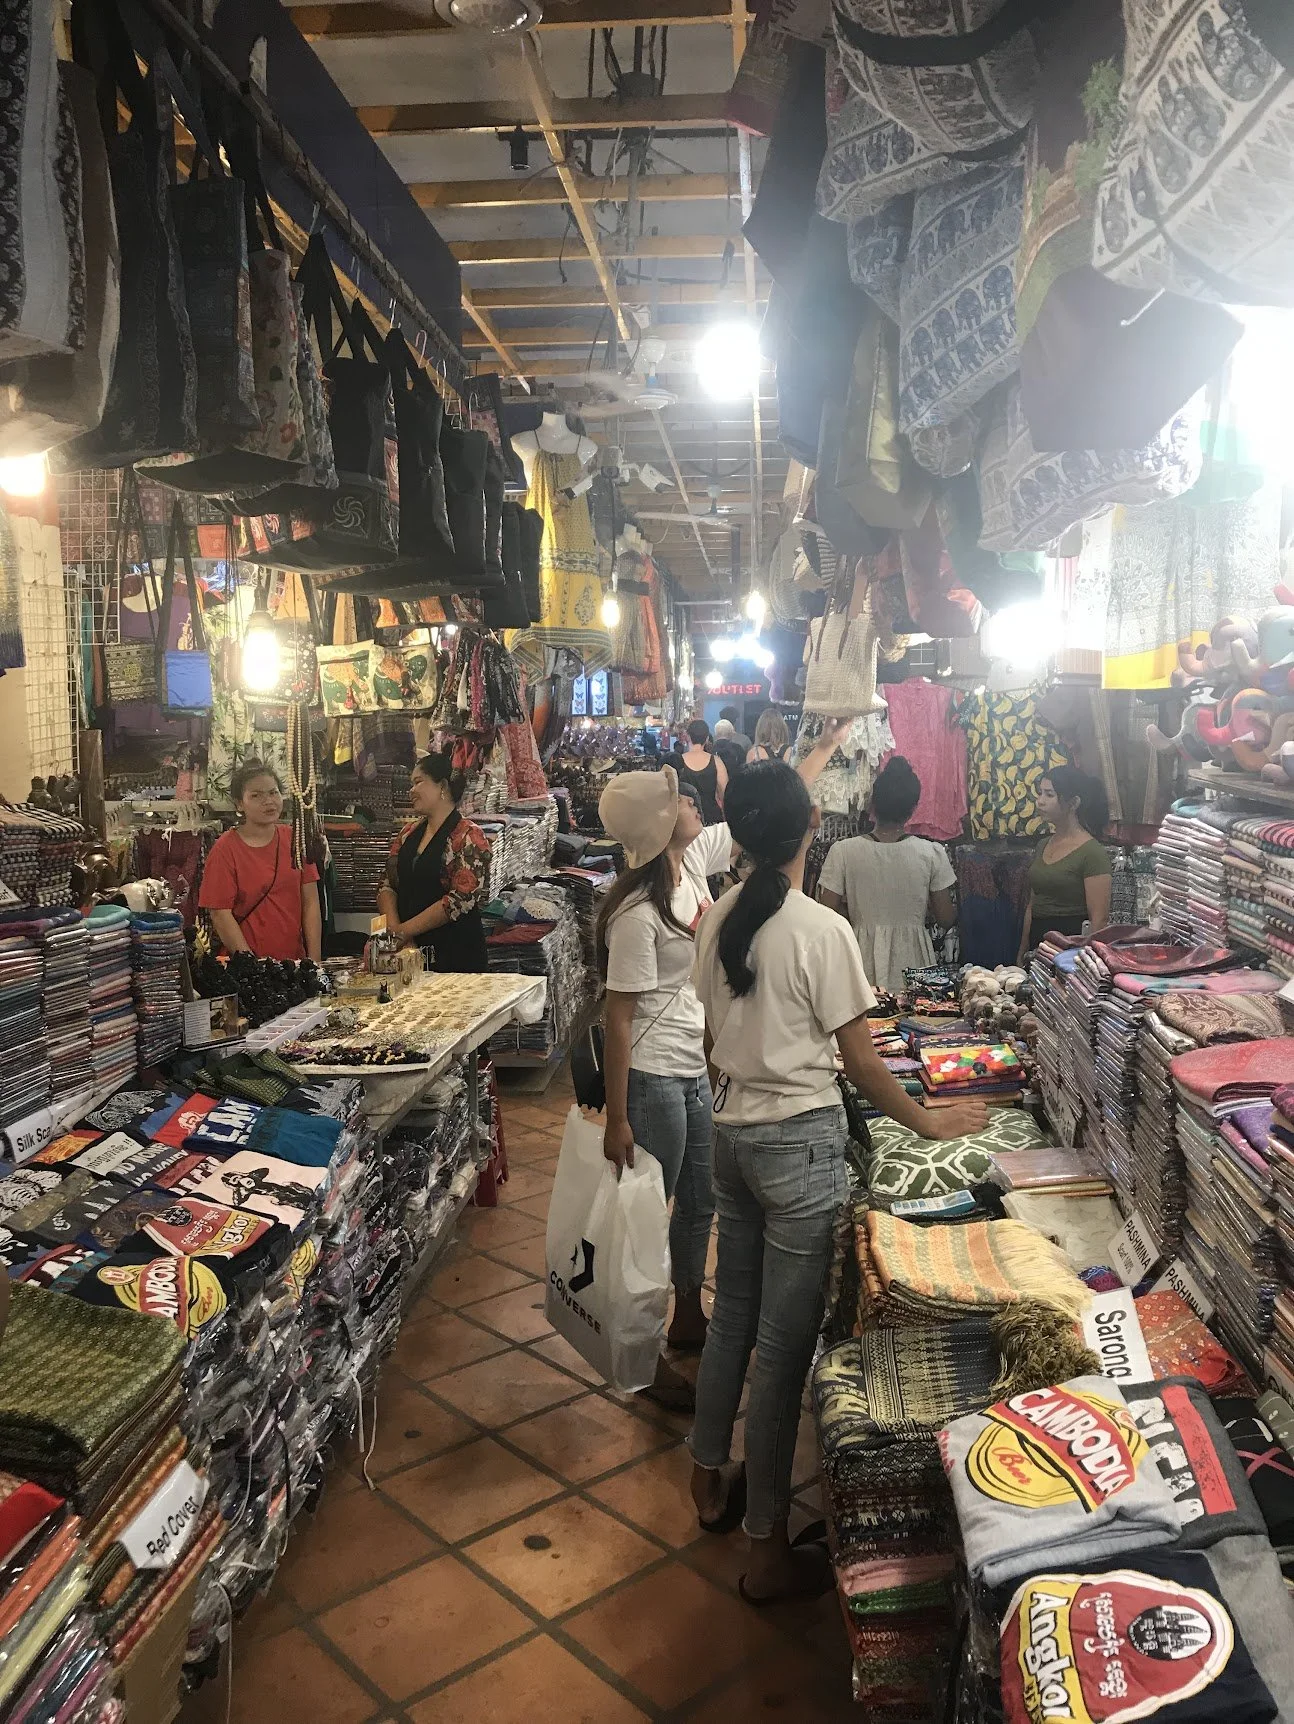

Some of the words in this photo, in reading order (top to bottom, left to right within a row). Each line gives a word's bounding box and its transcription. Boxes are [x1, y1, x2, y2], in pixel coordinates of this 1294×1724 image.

[16, 1132, 35, 1153] Silk
[1124, 1219, 1152, 1271] PASHMINA
[550, 1270, 601, 1335] CONVERSE
[1094, 1309, 1133, 1379] Sarong
[1008, 1387, 1132, 1499] CAMBODIA
[167, 1496, 199, 1536] Cover
[1026, 1591, 1072, 1722] Angkor
